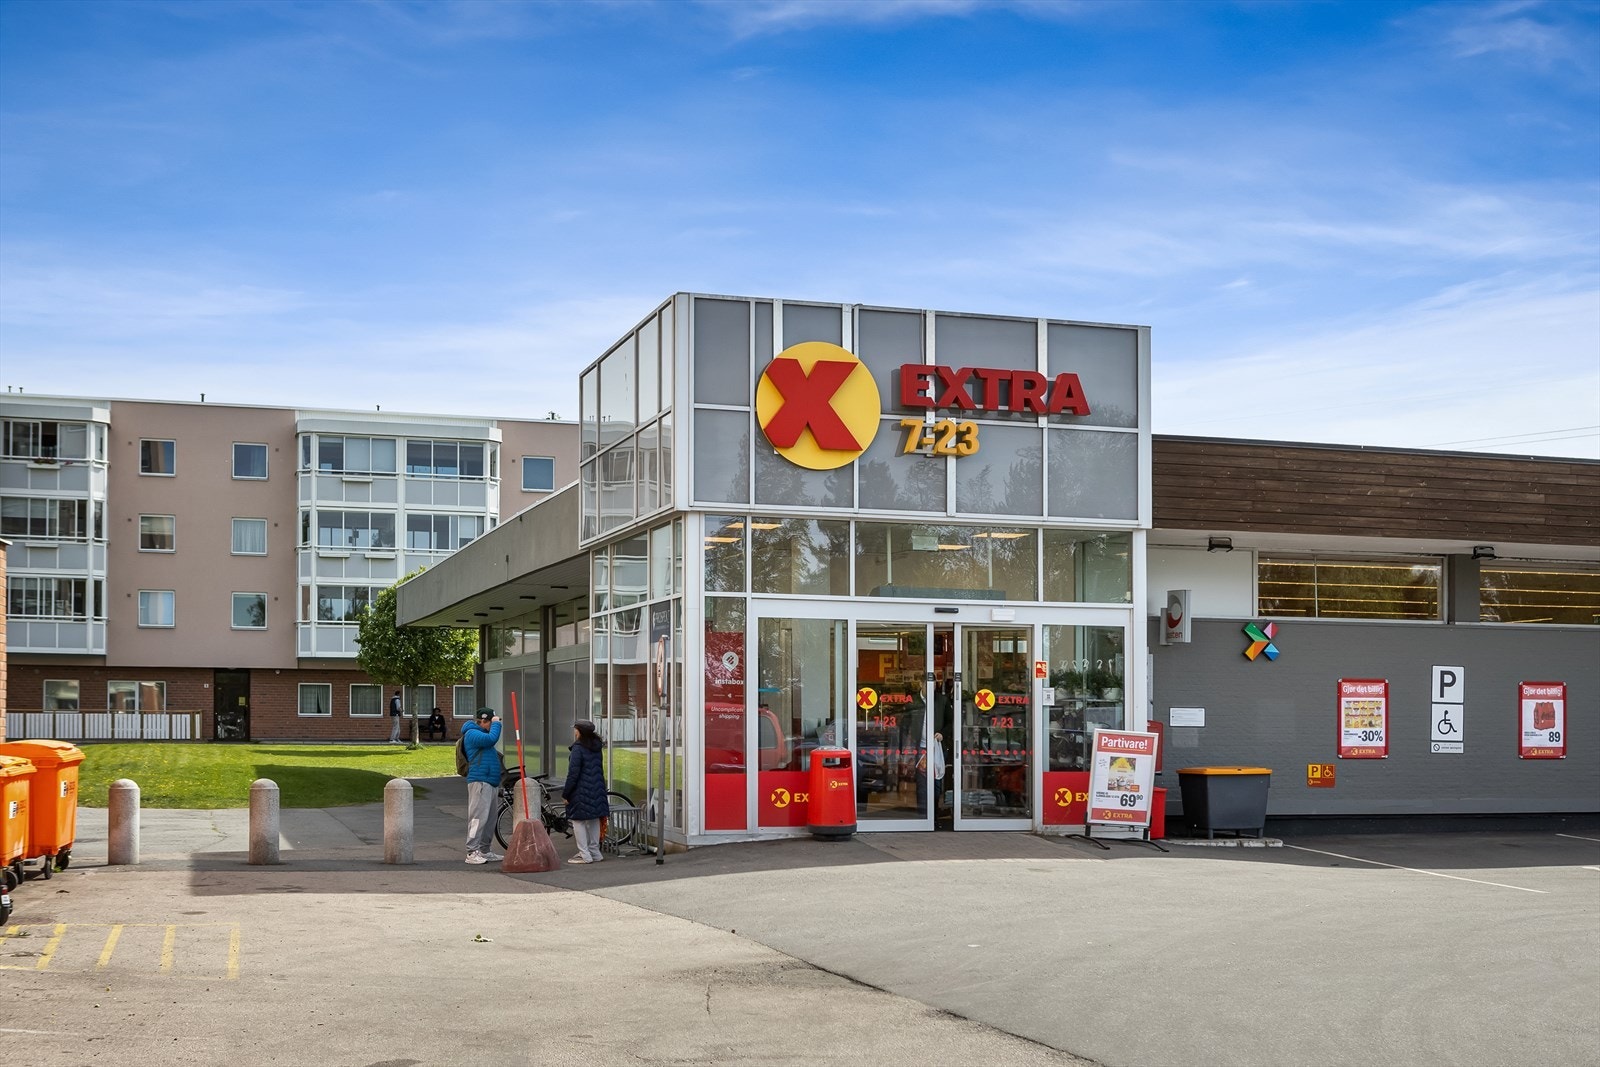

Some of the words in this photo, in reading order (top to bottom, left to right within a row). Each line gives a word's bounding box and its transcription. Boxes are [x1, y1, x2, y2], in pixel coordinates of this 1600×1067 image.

[900, 364, 1091, 416] EXTRA
[900, 418, 980, 456] 7-23
[1440, 670, 1456, 698] P
[880, 694, 913, 703] EXTRA
[998, 696, 1029, 704] EXTRA
[874, 716, 897, 727] 7-23
[992, 717, 1014, 728] 7-23
[1358, 730, 1384, 742] -30%
[1548, 731, 1561, 742] 89
[1101, 736, 1148, 750] Partivare!
[1312, 766, 1318, 776] P
